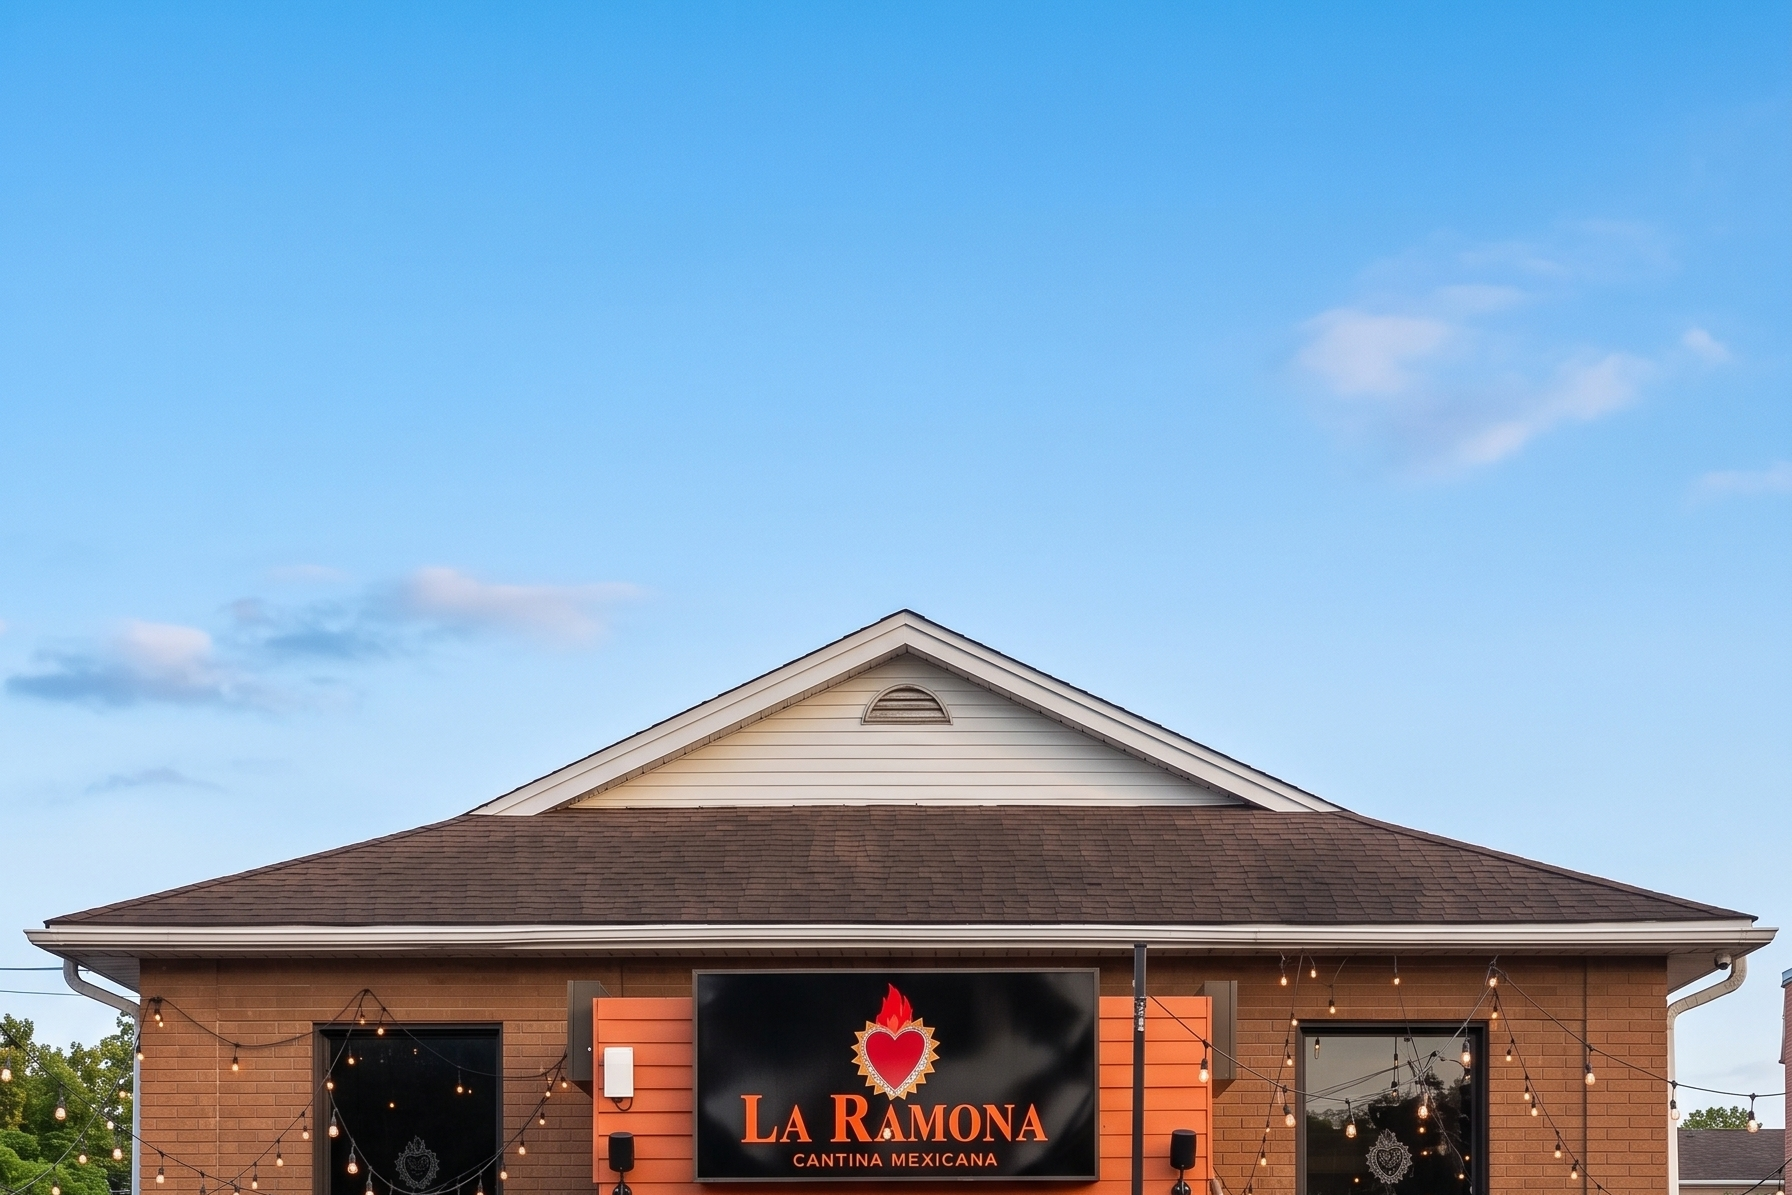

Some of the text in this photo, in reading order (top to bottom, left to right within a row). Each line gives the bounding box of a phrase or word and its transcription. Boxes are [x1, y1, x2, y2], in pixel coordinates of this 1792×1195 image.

[741, 1094, 1048, 1143] LA RAMONA
[793, 1152, 998, 1168] CANTINA MEXICANA
